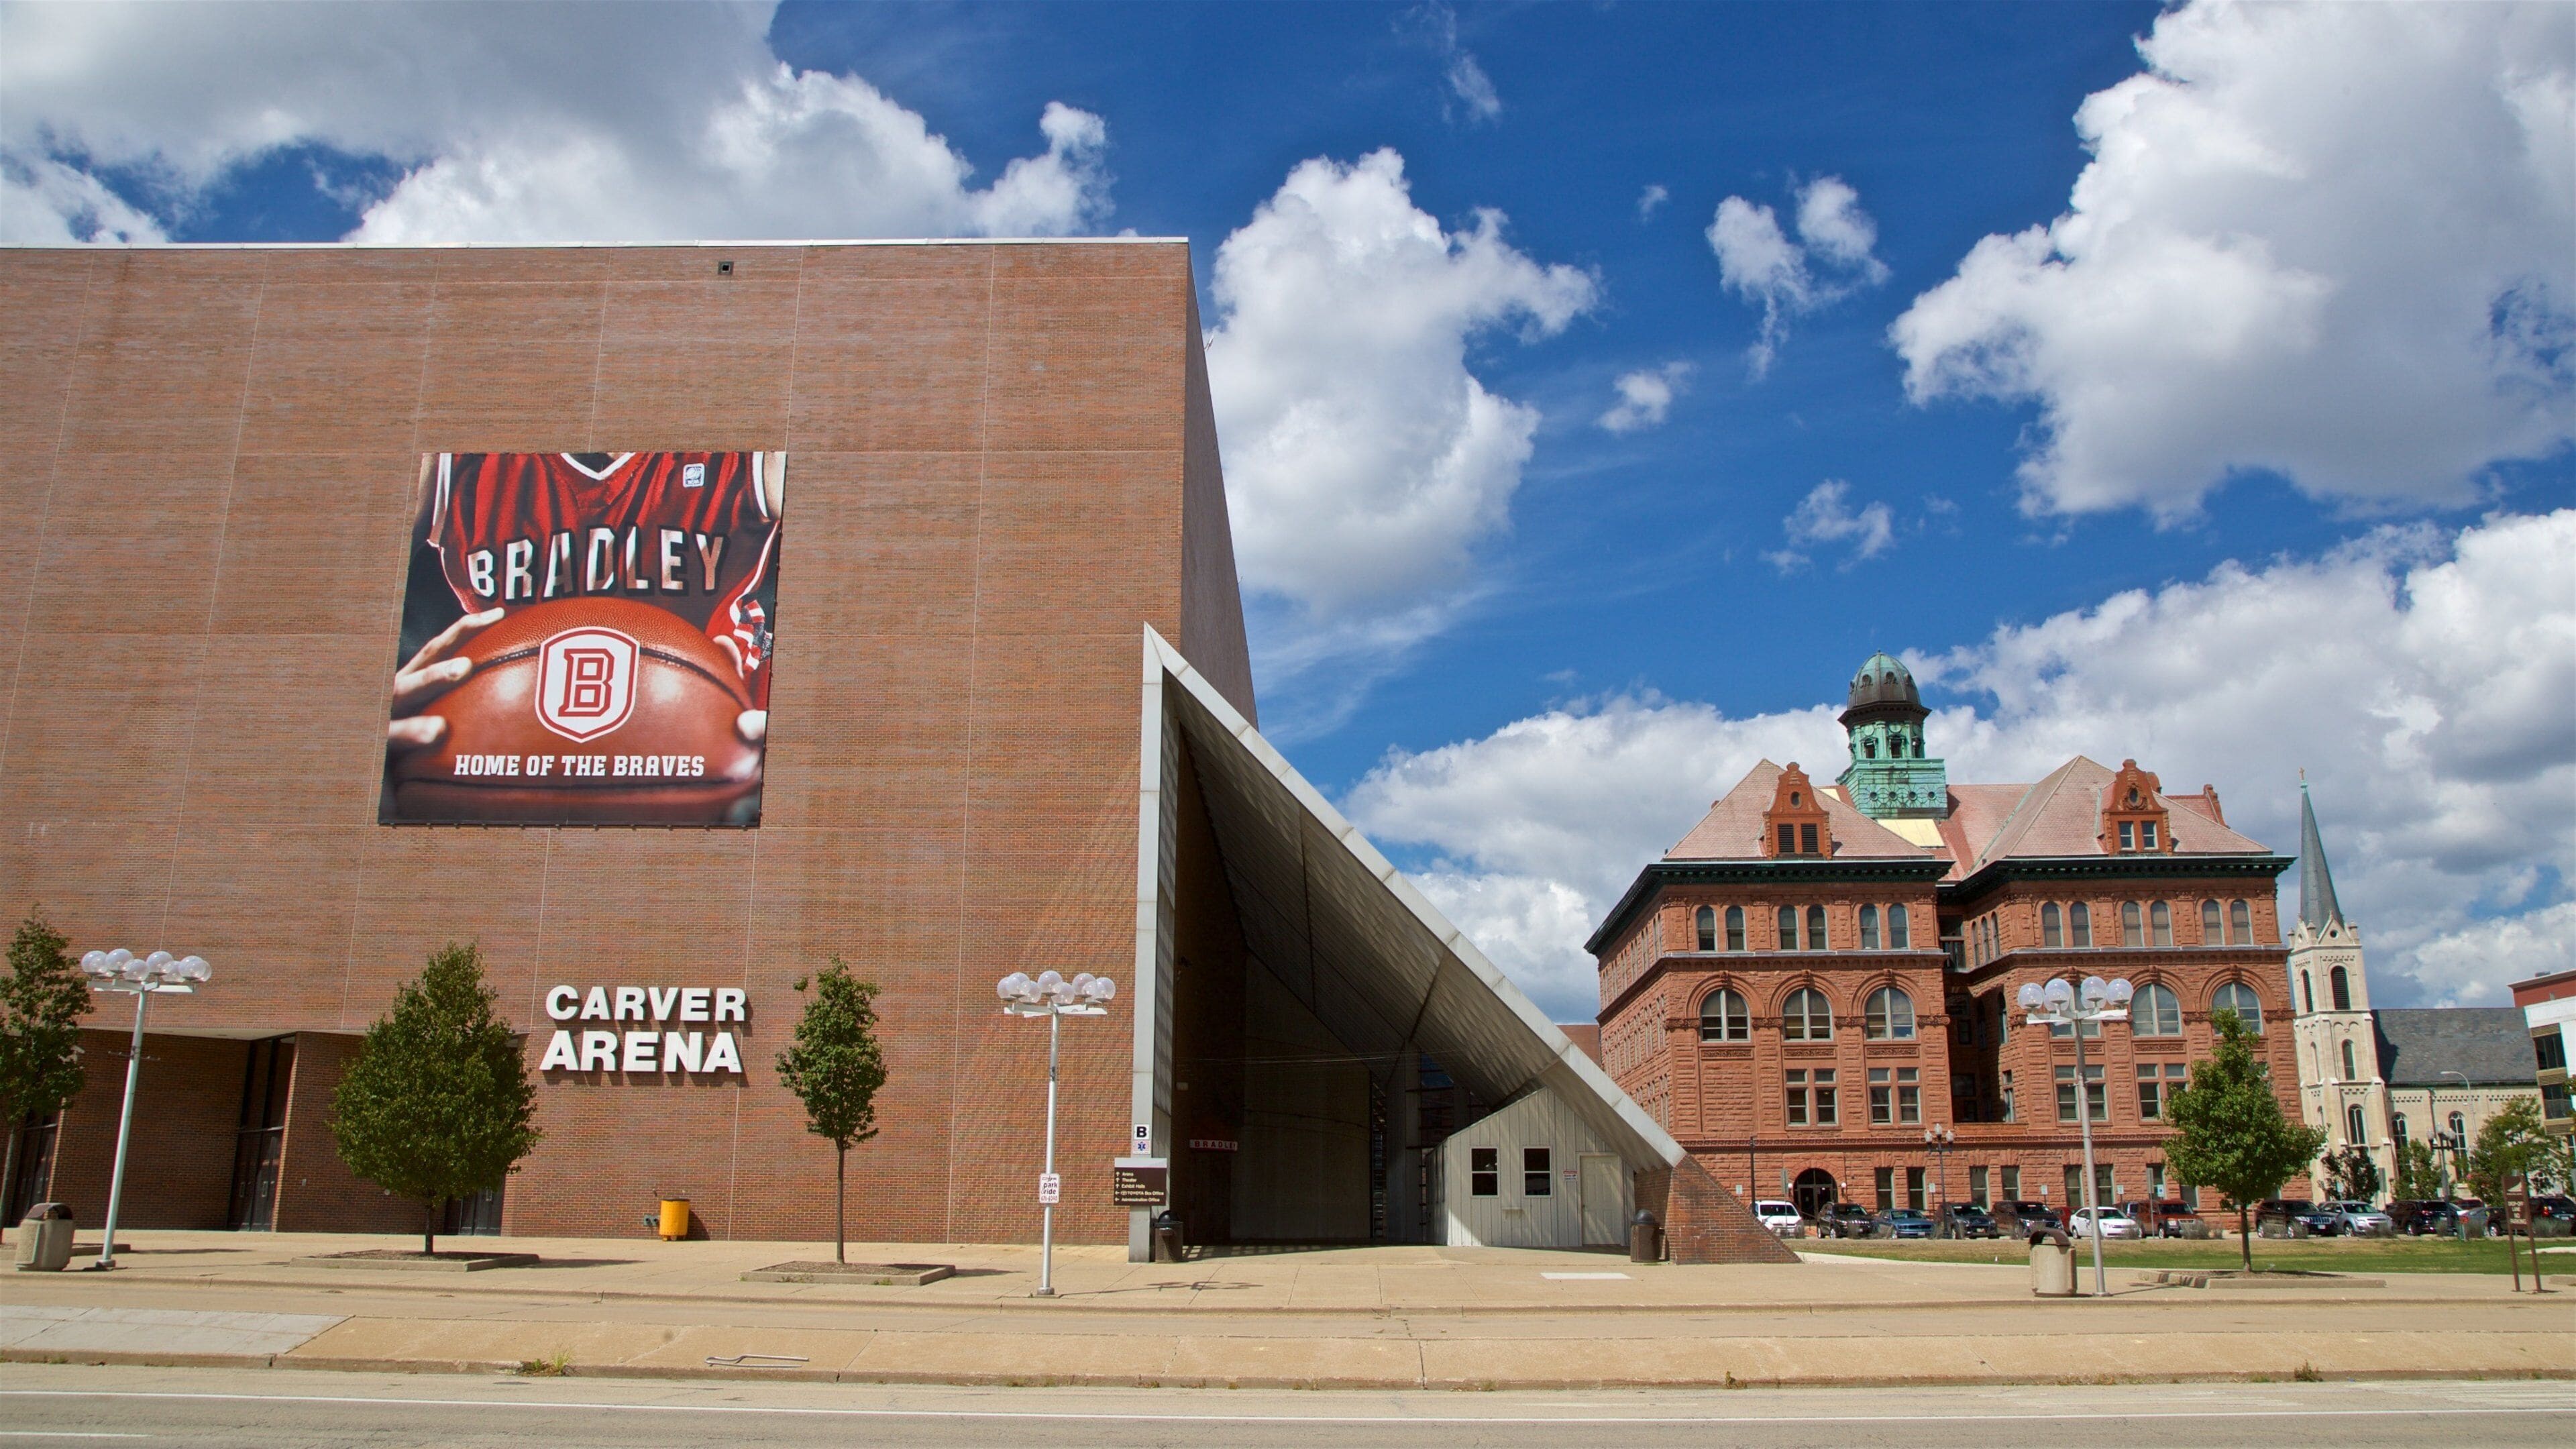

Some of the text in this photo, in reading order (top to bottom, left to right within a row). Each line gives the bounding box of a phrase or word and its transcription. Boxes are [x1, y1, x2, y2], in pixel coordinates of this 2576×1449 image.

[466, 525, 724, 600] BRADLEY
[558, 649, 614, 716] B
[453, 754, 705, 776] HOME OF THE BRAVES
[545, 985, 747, 1022] CARVER
[539, 1030, 743, 1073] ARENA
[1136, 1126, 1147, 1138] B
